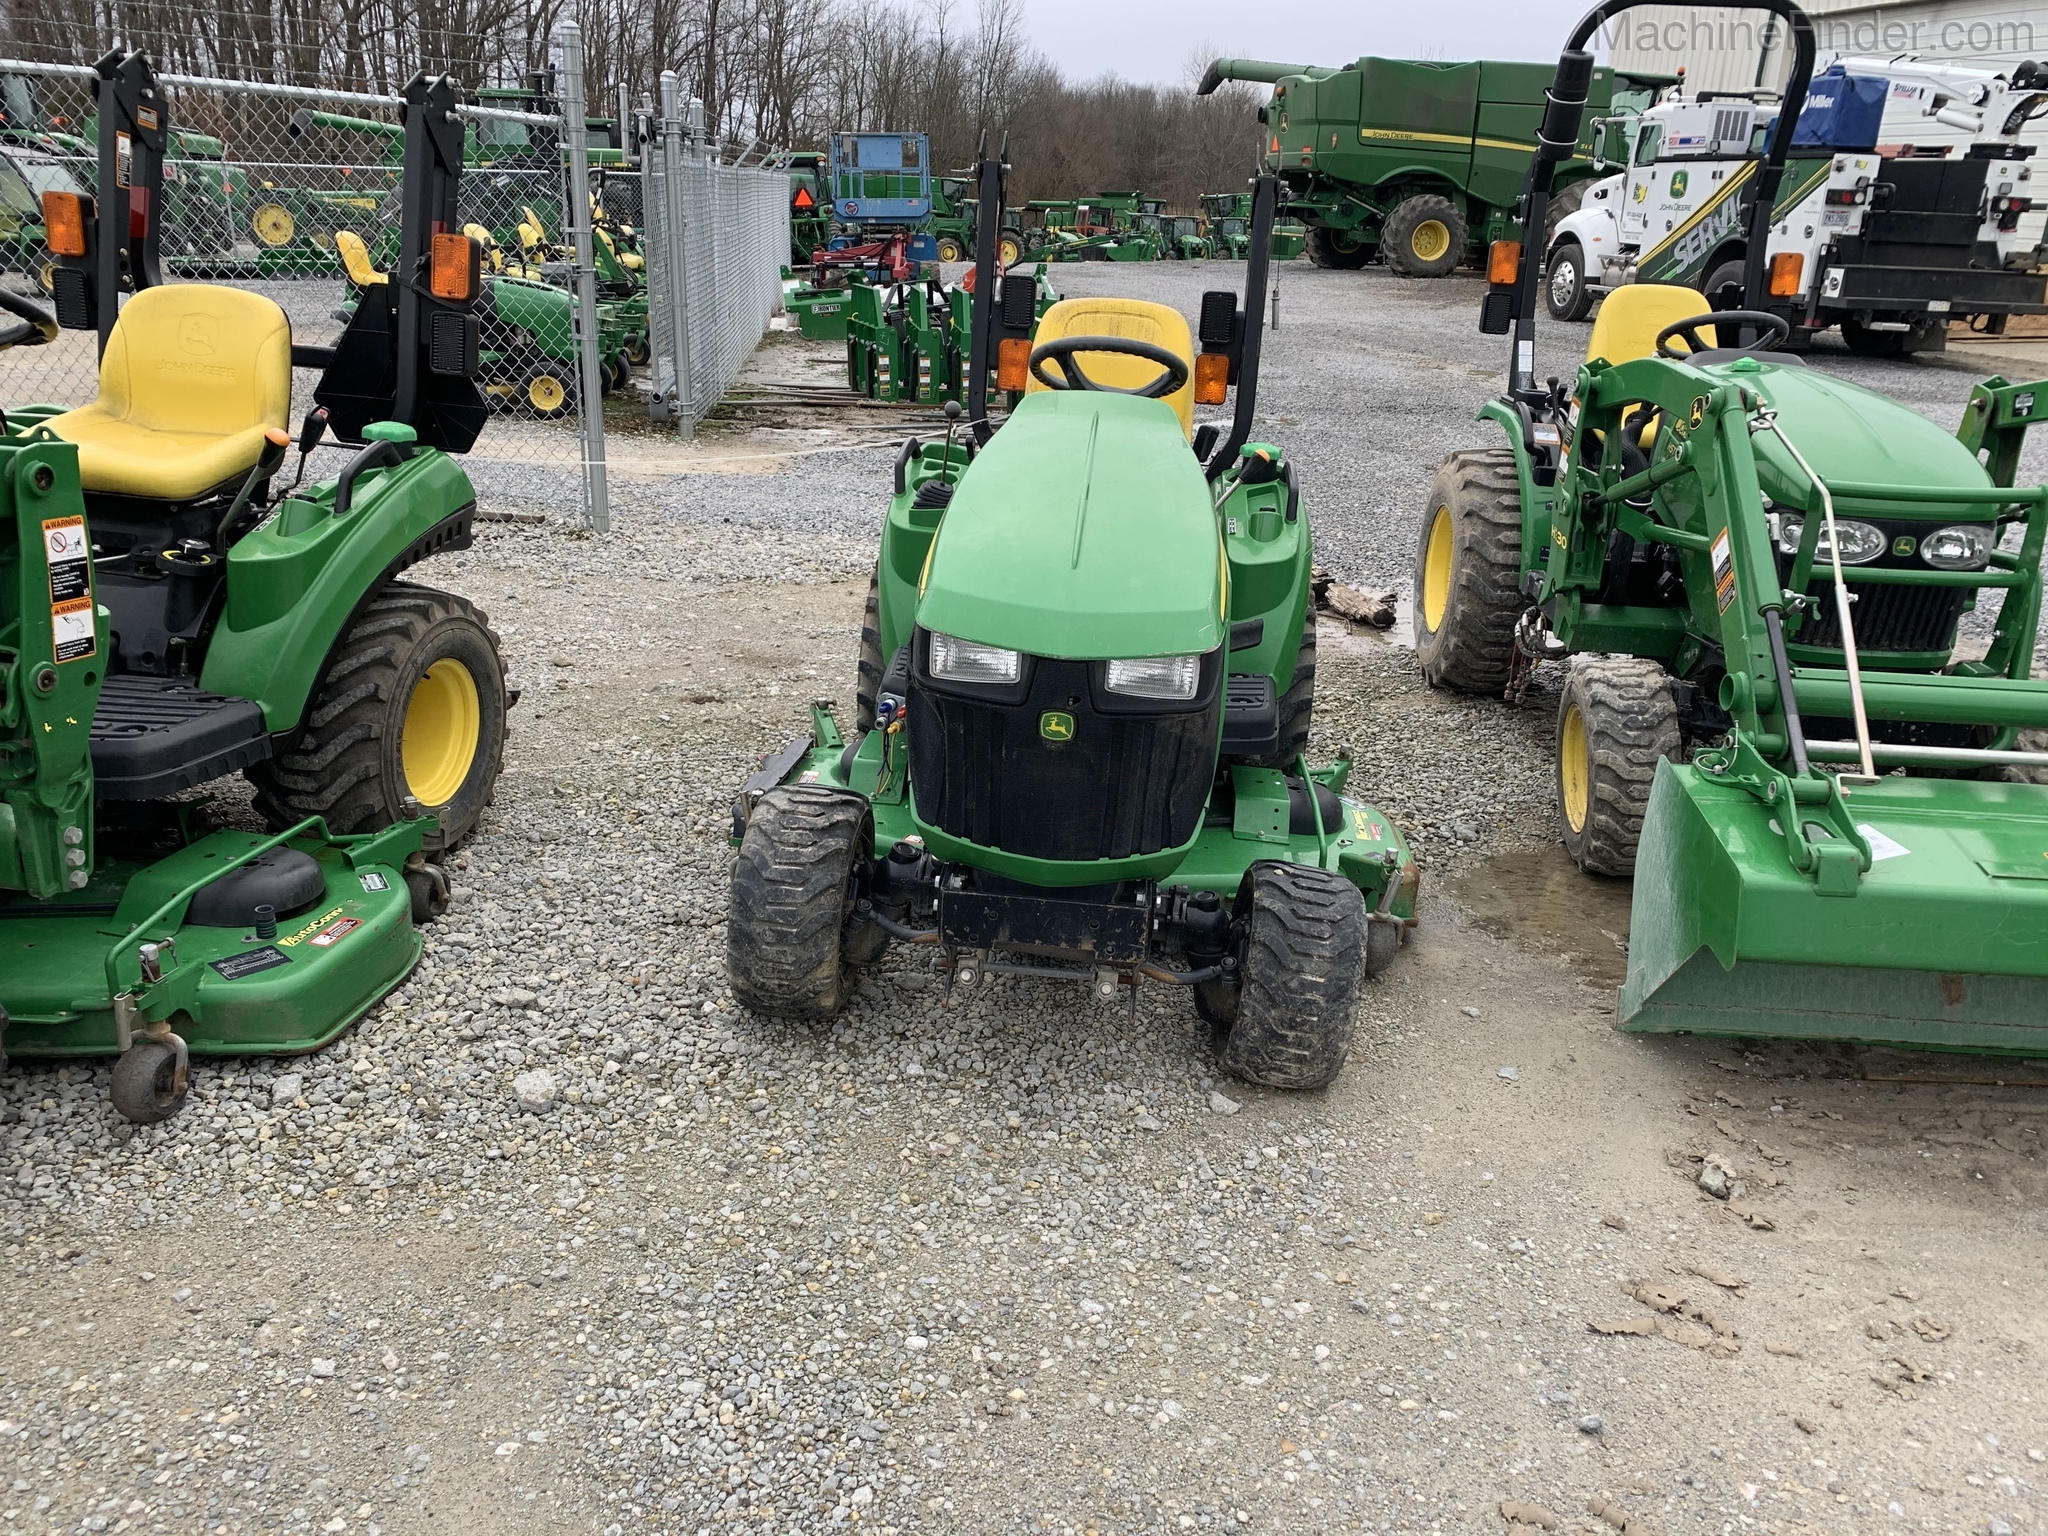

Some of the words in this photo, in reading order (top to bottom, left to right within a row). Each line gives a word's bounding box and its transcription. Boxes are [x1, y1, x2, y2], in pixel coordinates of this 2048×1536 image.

[1809, 94, 1834, 108] Miller
[1659, 202, 1674, 211] JOHN
[1674, 203, 1692, 212] DEERE
[1674, 190, 1741, 274] SERVI
[50, 517, 82, 529] WARNING
[60, 600, 91, 613] WARNING
